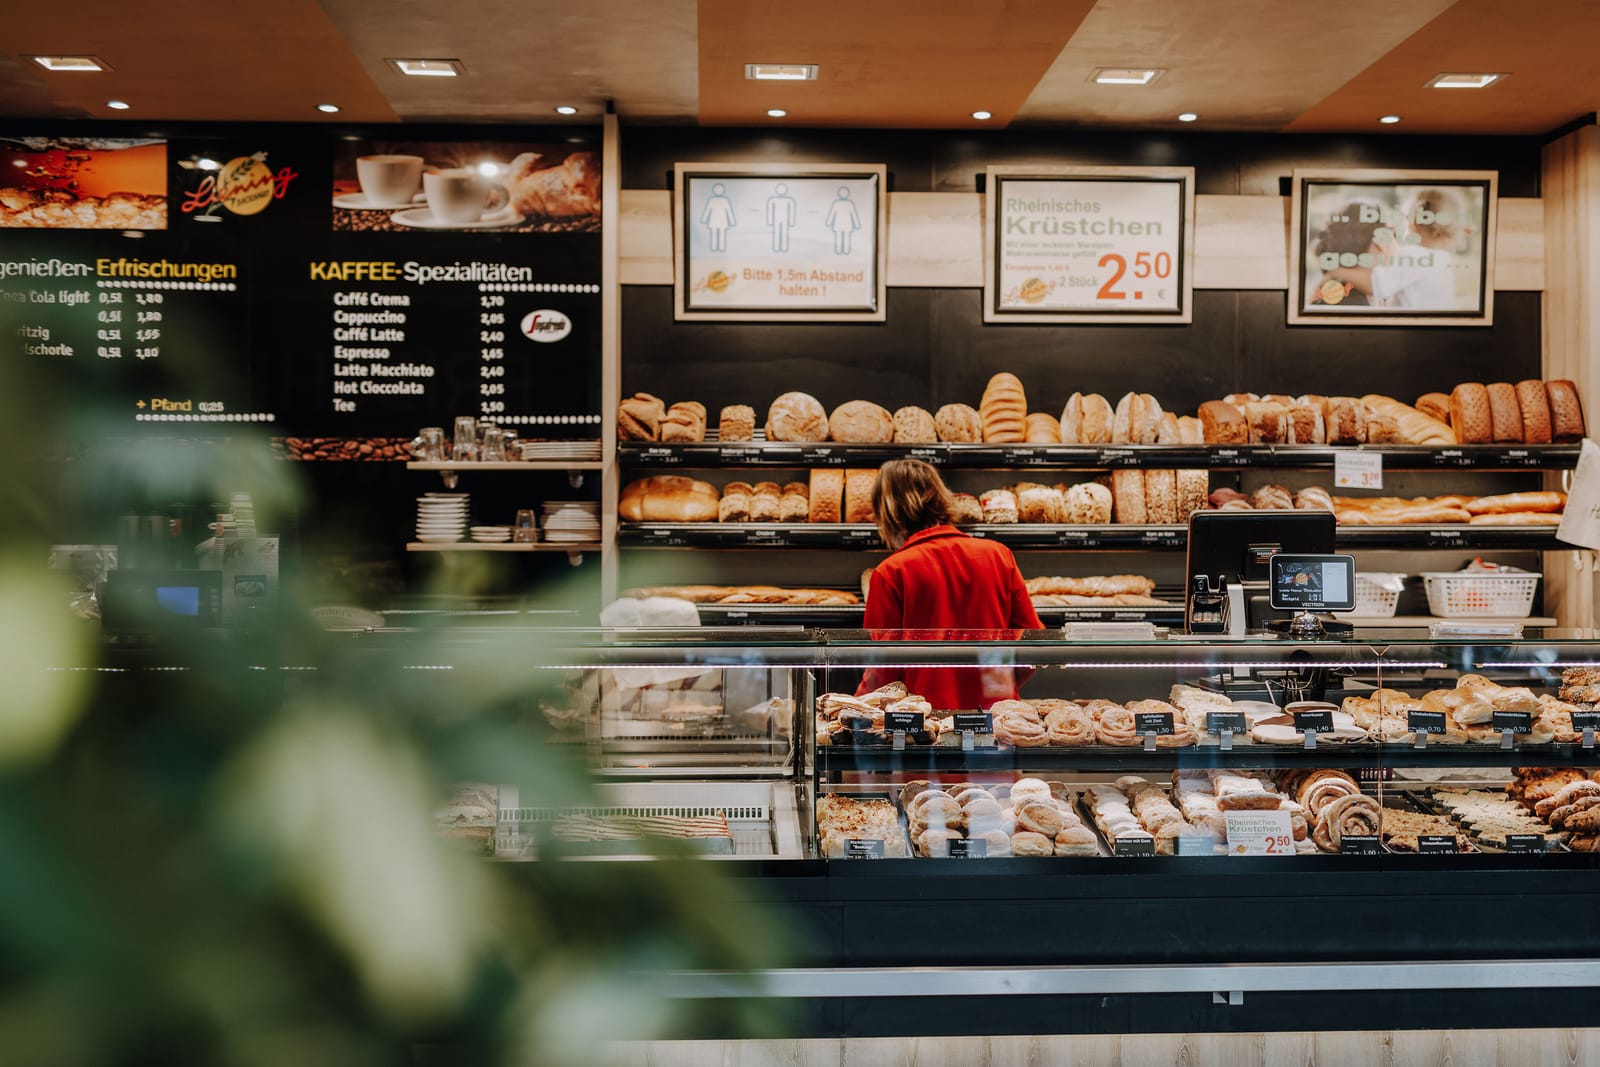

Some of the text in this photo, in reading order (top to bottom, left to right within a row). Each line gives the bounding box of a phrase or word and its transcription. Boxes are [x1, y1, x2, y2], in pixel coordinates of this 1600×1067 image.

[1006, 198, 1101, 213] Rheinisches
[1006, 216, 1163, 236] Krüstchen
[743, 267, 864, 283] Bitte 1,5m Abstand
[1069, 275, 1098, 288] Stück
[30, 290, 55, 303] Cola
[59, 289, 91, 306] light
[779, 284, 818, 296] halten
[370, 292, 411, 307] Crema
[333, 310, 406, 325] Cappuccino
[370, 328, 405, 342] Latte
[334, 346, 390, 361] Espresso
[334, 364, 368, 377] Latte
[371, 363, 435, 378] Macchiato
[334, 381, 358, 394] Hot
[360, 380, 424, 395] Cioccolata
[151, 399, 192, 412] Pfand
[333, 399, 356, 412] Tee
